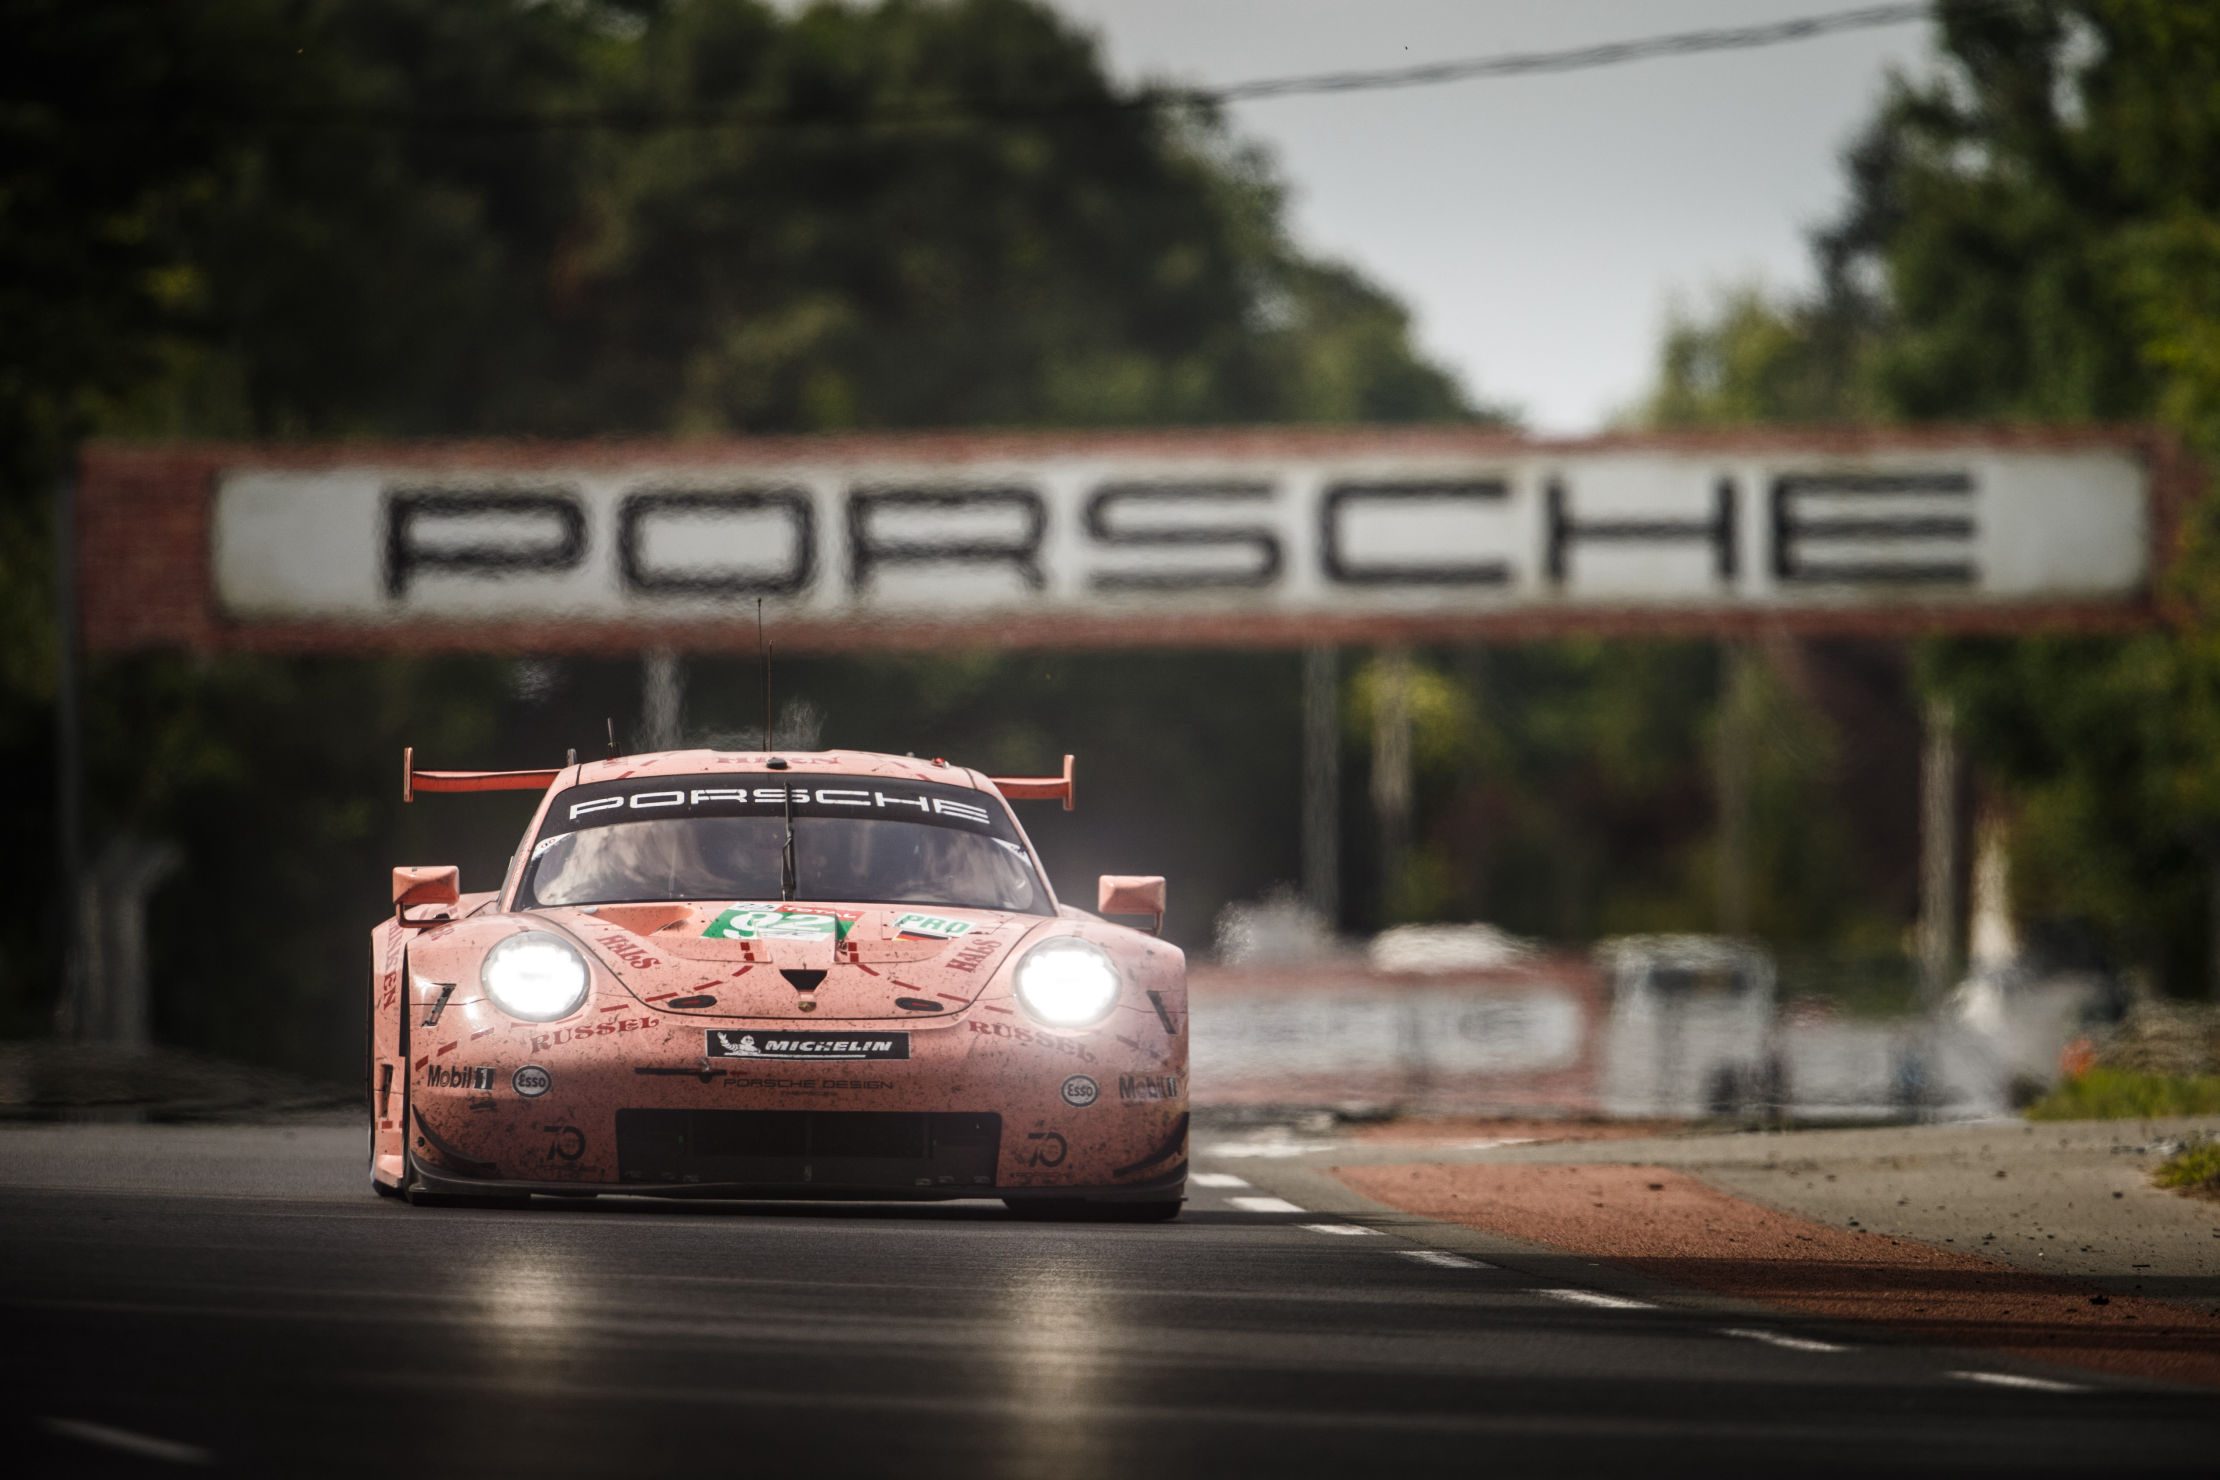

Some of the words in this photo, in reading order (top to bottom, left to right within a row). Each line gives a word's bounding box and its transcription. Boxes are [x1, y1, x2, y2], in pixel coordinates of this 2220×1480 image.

[382, 472, 1978, 601] PORSCHE
[568, 788, 991, 825] PORSCHE
[722, 911, 836, 940] 92
[784, 906, 858, 919] TOTAL
[899, 914, 970, 934] PRO
[595, 934, 662, 969] HALS
[945, 938, 1002, 974] HALS
[764, 1040, 894, 1052] MICHELIN
[426, 1064, 473, 1089] Mobil
[517, 1073, 547, 1089] Esso
[723, 1078, 818, 1089] PORSCHE
[823, 1079, 894, 1090] DESIGN
[1066, 1083, 1094, 1097] Esso
[543, 1125, 586, 1161] 70
[1027, 1131, 1067, 1168] 70
